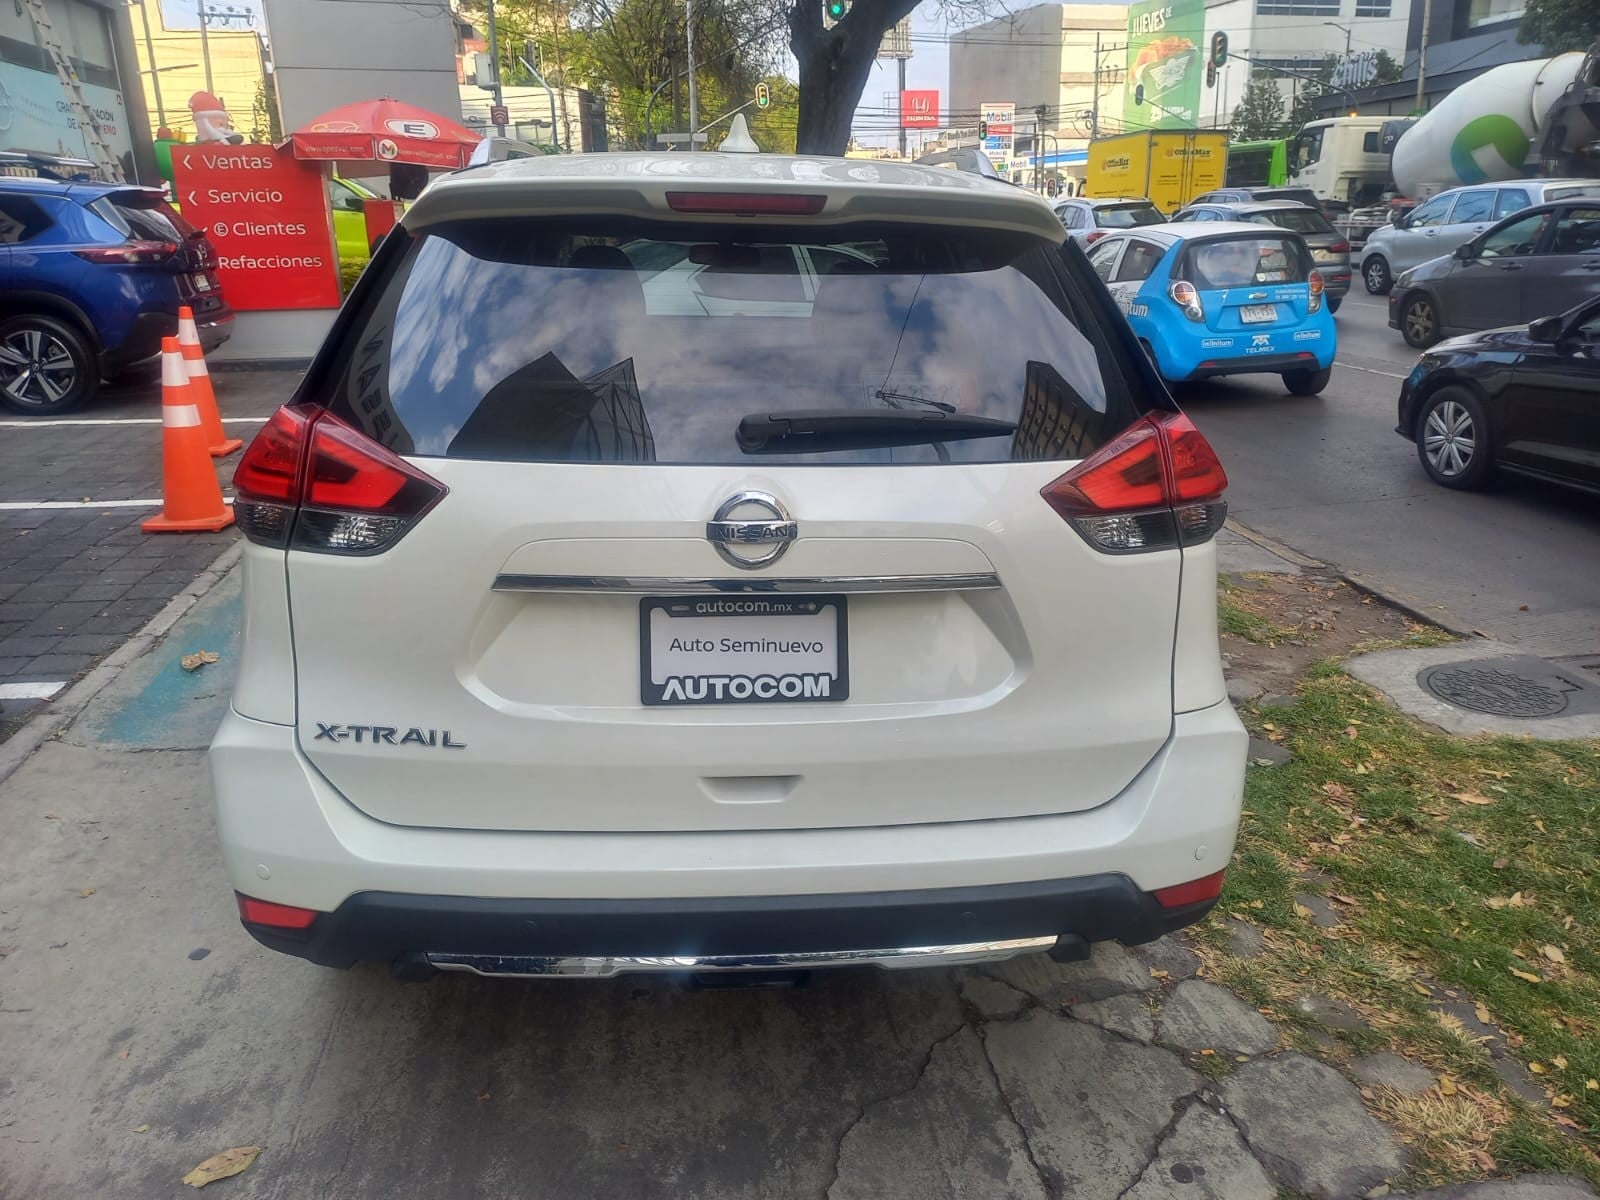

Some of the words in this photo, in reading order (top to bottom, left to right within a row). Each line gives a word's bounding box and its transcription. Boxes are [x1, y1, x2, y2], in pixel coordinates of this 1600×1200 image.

[1132, 8, 1166, 38] JUEVES
[986, 112, 1012, 122] Mobil
[203, 155, 273, 169] Ventas
[1010, 160, 1027, 168] Mobil
[208, 188, 283, 203] Servicio
[233, 222, 306, 236] Clientes
[218, 255, 322, 269] Refacciones
[1245, 346, 1275, 354] TELMEX
[719, 526, 788, 539] NISSAN
[696, 600, 793, 613] autocom.mx
[669, 638, 715, 652] Auto
[719, 637, 823, 653] Seminuevo
[662, 675, 831, 701] AUTOCOM
[313, 720, 468, 749] X-TRAIL
